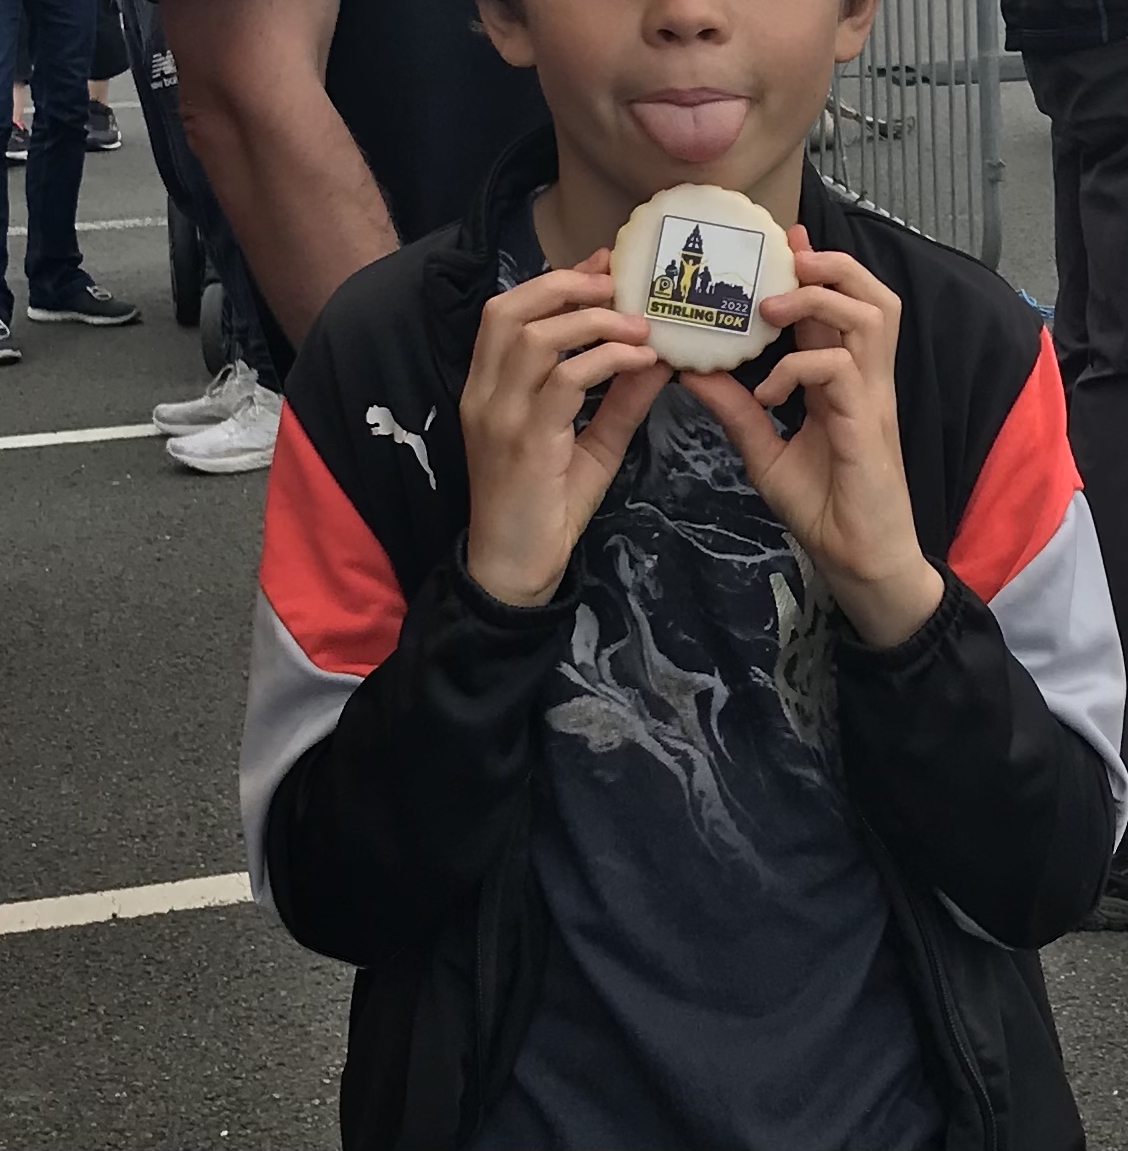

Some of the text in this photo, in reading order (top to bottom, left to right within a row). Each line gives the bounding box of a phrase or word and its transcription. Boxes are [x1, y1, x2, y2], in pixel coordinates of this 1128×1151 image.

[650, 301, 745, 328] STIRLING 10K
[720, 299, 749, 313] 2022
